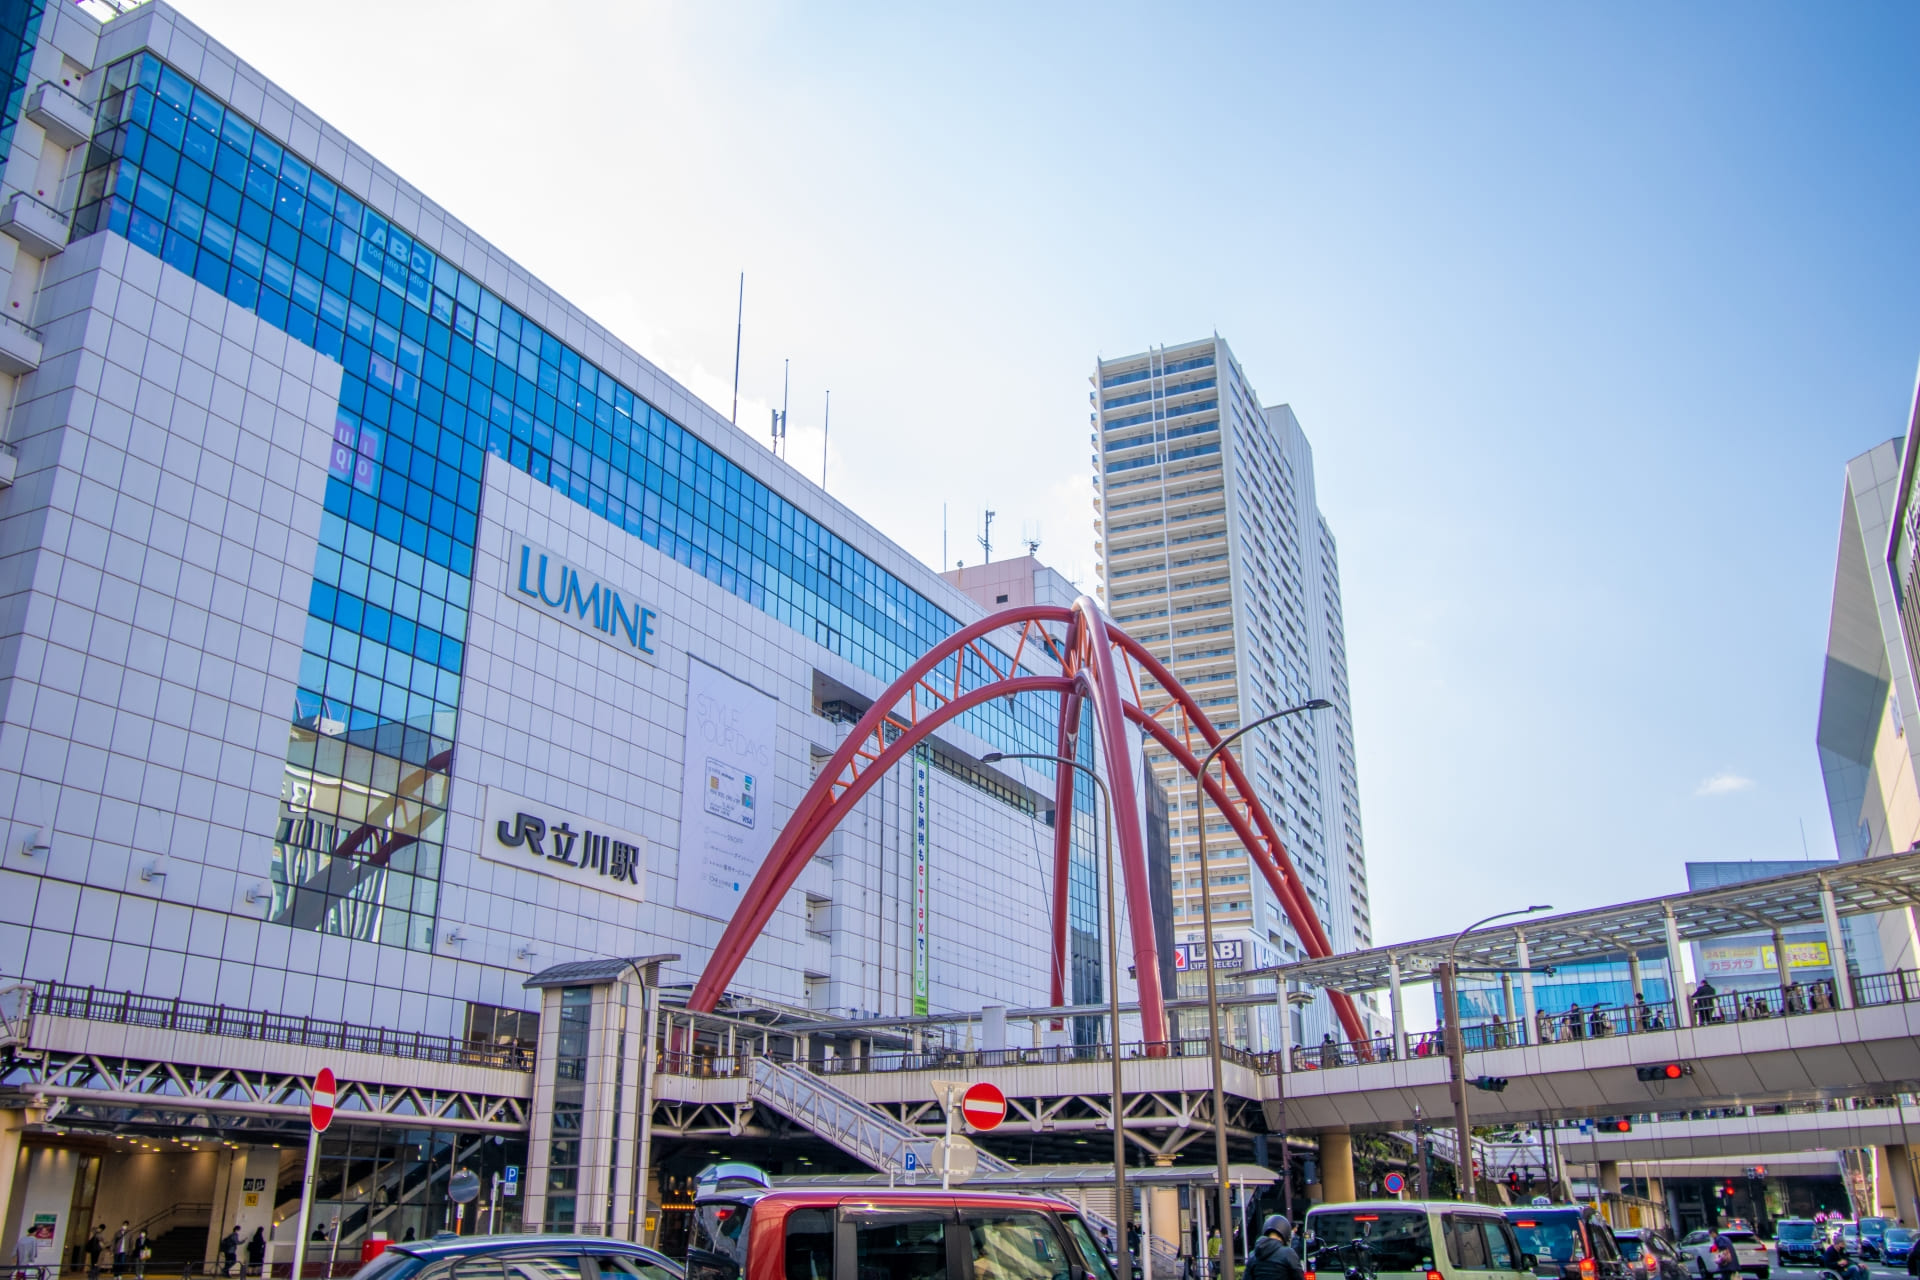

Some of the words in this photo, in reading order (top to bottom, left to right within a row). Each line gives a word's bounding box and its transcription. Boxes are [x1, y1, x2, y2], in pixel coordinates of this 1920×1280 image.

[368, 243, 398, 273] Cooing
[400, 266, 424, 288] Sudio
[370, 227, 426, 275] ABC
[518, 544, 656, 655] LUMINE
[508, 1168, 516, 1181] P
[908, 1154, 914, 1169] P
